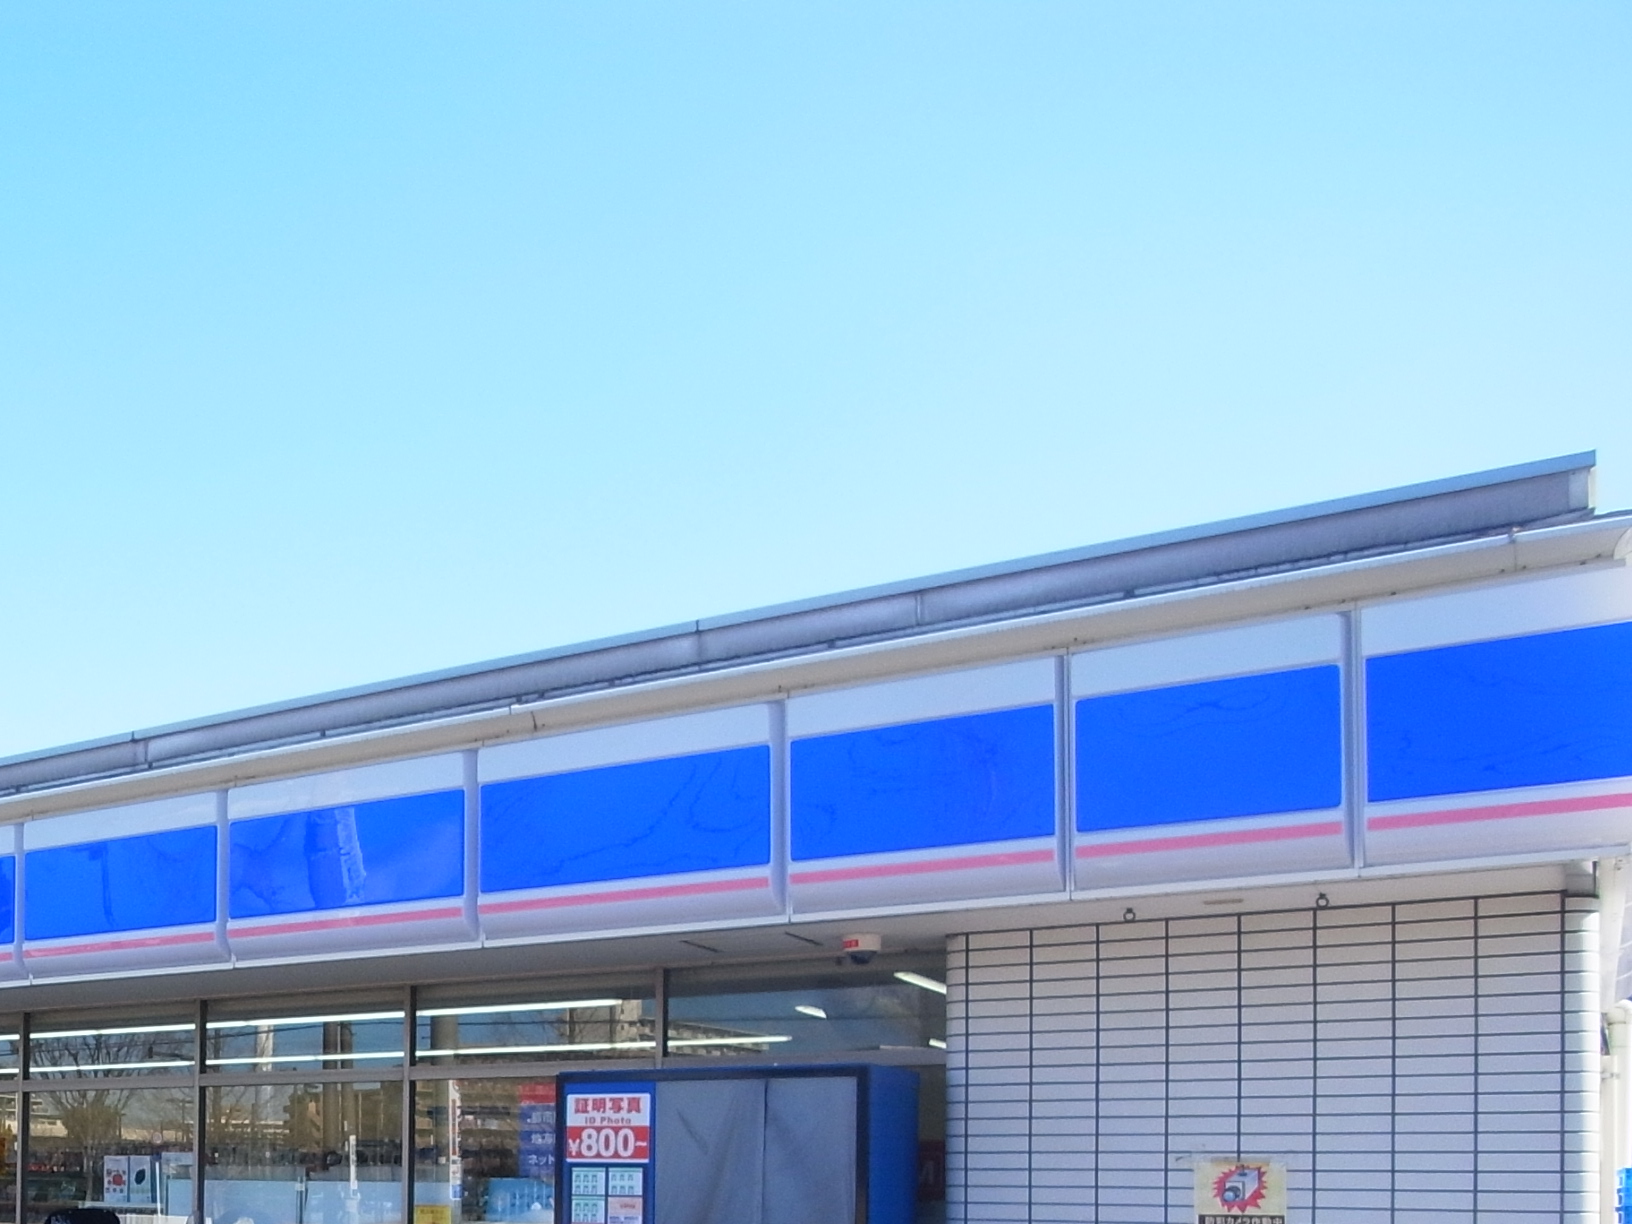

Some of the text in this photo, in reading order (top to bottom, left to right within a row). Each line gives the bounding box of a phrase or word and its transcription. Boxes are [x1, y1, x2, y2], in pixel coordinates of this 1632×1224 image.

[574, 1097, 641, 1114] 証明写真
[585, 1116, 632, 1125] ID Photo
